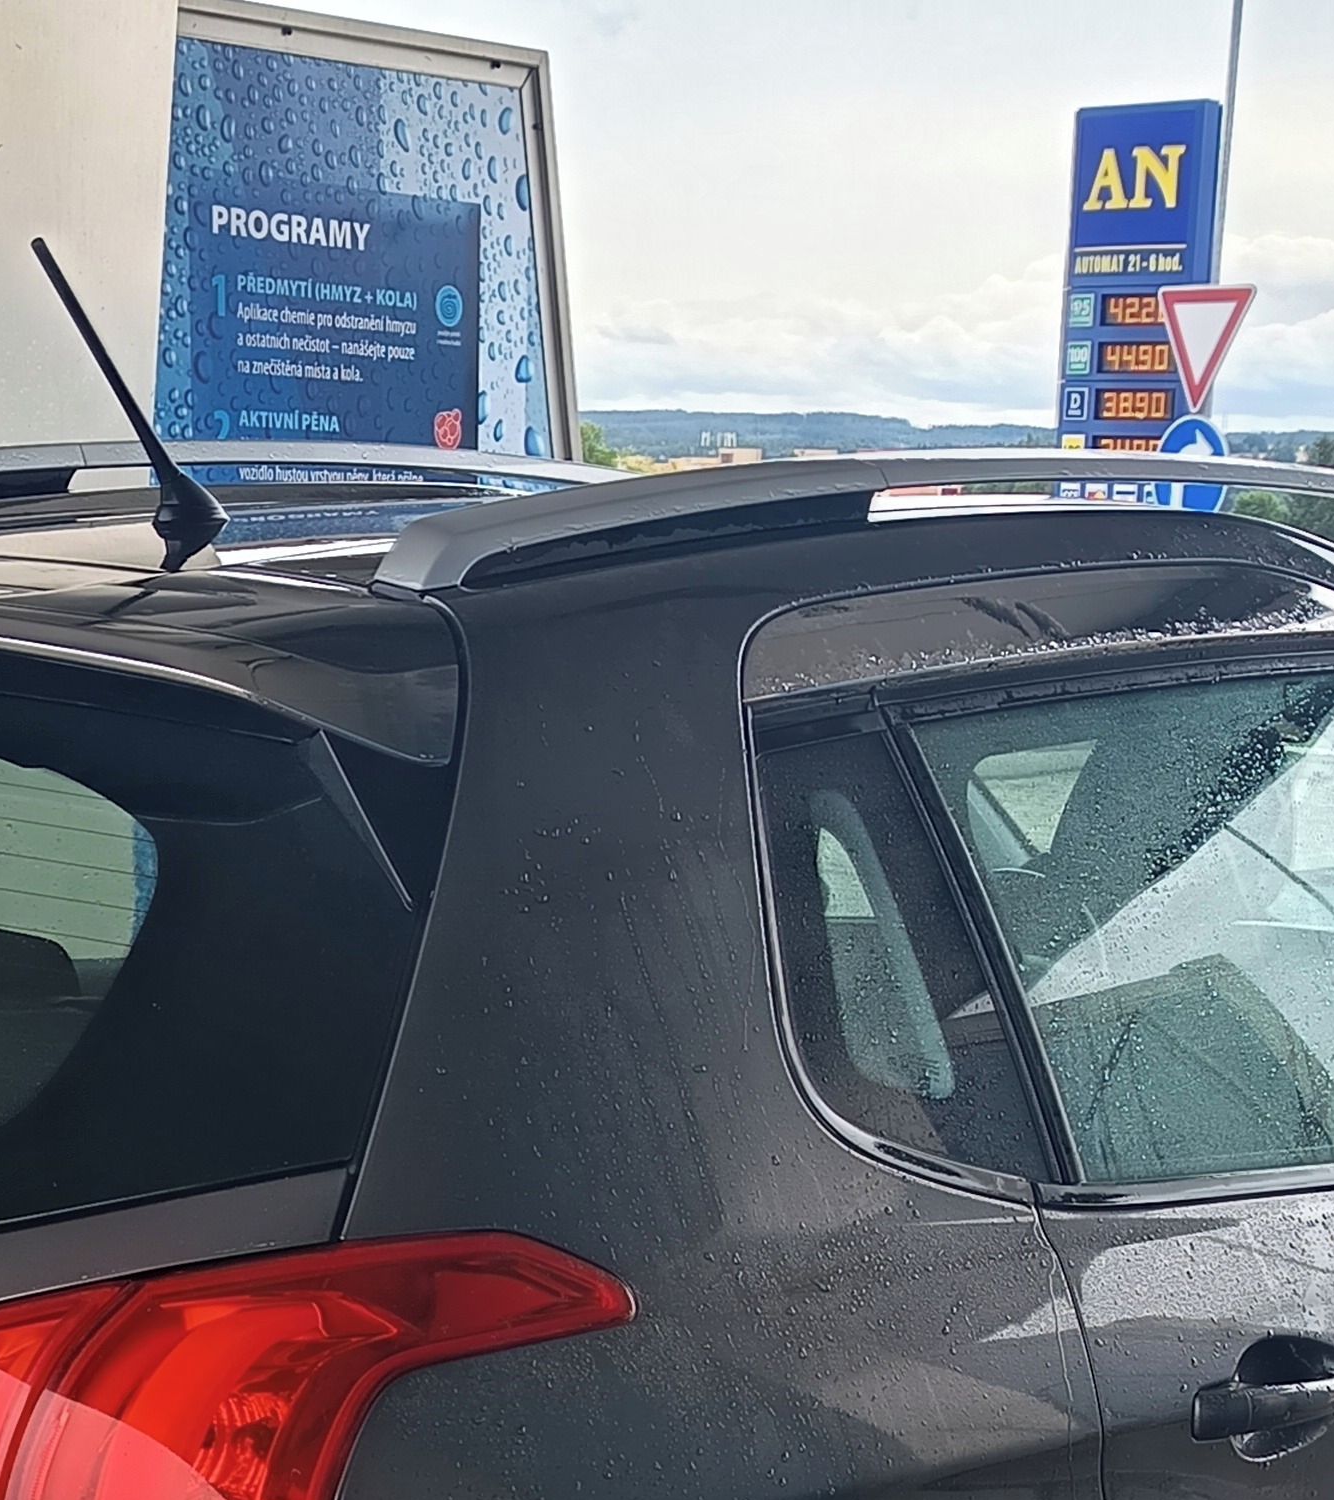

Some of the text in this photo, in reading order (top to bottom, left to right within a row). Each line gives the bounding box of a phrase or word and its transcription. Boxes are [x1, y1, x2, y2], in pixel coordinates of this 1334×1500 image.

[1083, 144, 1187, 211] AN
[211, 204, 371, 251] PROGRAMY
[1074, 254, 1125, 274] AUTOMAT
[211, 272, 417, 317] 1 PŘEDMYTÍ (HMYZ + KOLA)
[237, 302, 417, 336] Aplikace chemie pro odstranění hmyzu
[237, 333, 244, 346] a
[245, 332, 291, 350] ostatních
[292, 335, 330, 353] nečistot
[341, 340, 386, 360] nanášejte
[388, 346, 415, 361] pouze
[237, 358, 364, 382] na znečištěná místa a kola.
[1070, 393, 1081, 409] D
[239, 409, 299, 430] AKTIVNÍ
[301, 411, 340, 432] PĚNA
[239, 464, 274, 481] vozidlo
[275, 465, 309, 482] hustou
